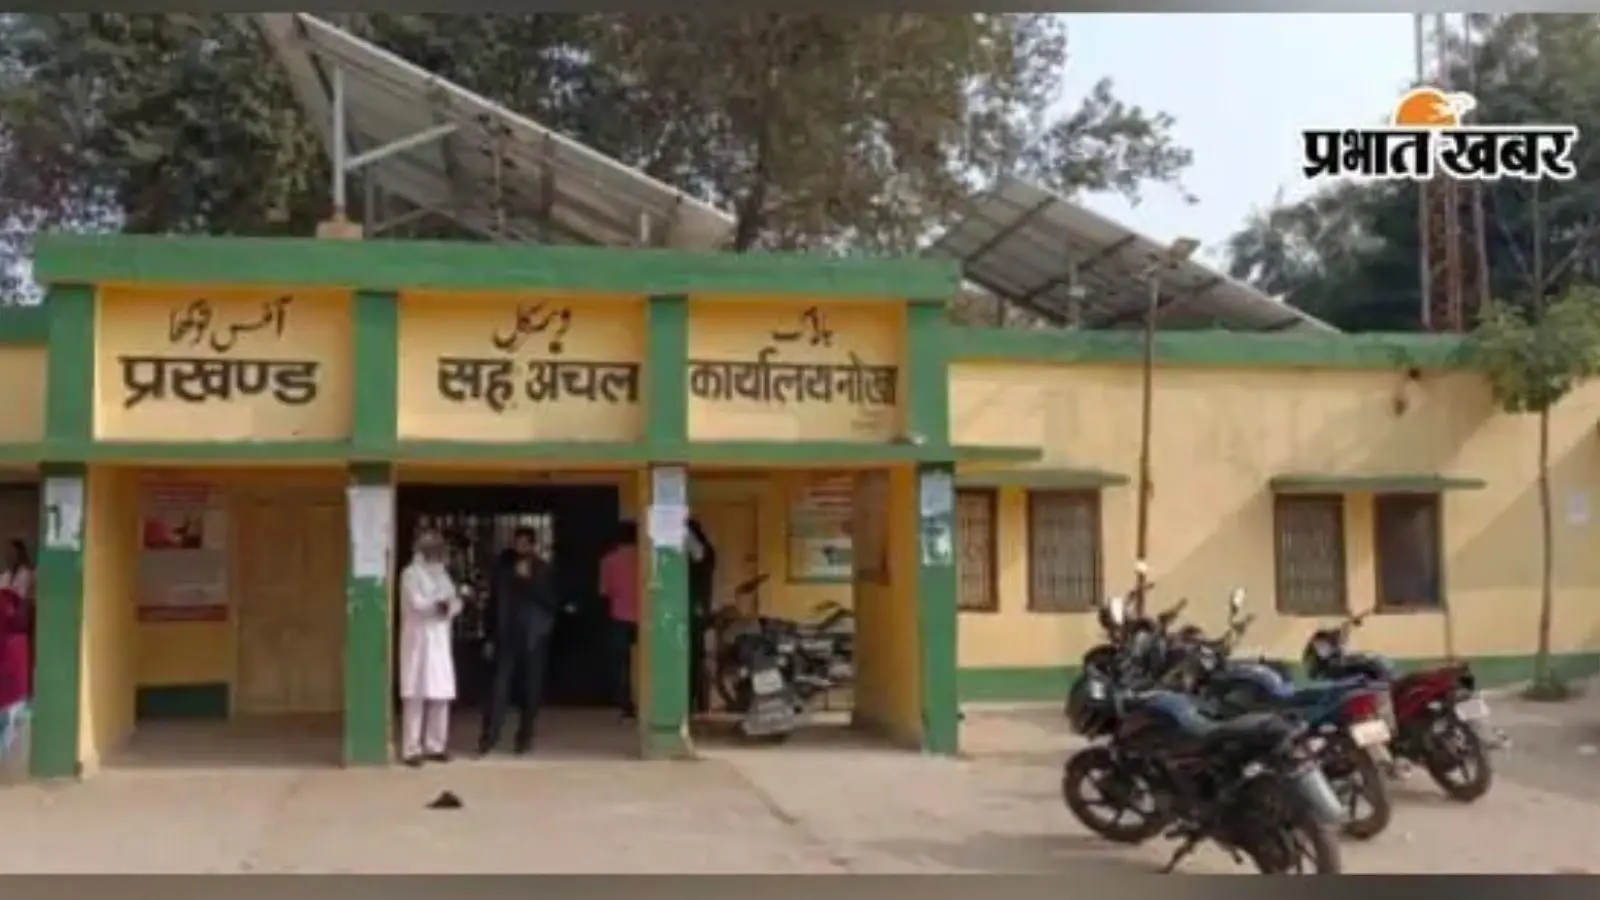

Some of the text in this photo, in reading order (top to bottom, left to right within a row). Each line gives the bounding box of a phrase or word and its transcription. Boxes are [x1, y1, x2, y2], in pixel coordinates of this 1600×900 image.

[118, 355, 319, 410] प्रखण्ड
[437, 356, 514, 414] सह
[525, 341, 642, 404] अंचल
[686, 347, 833, 405] कार्यालय
